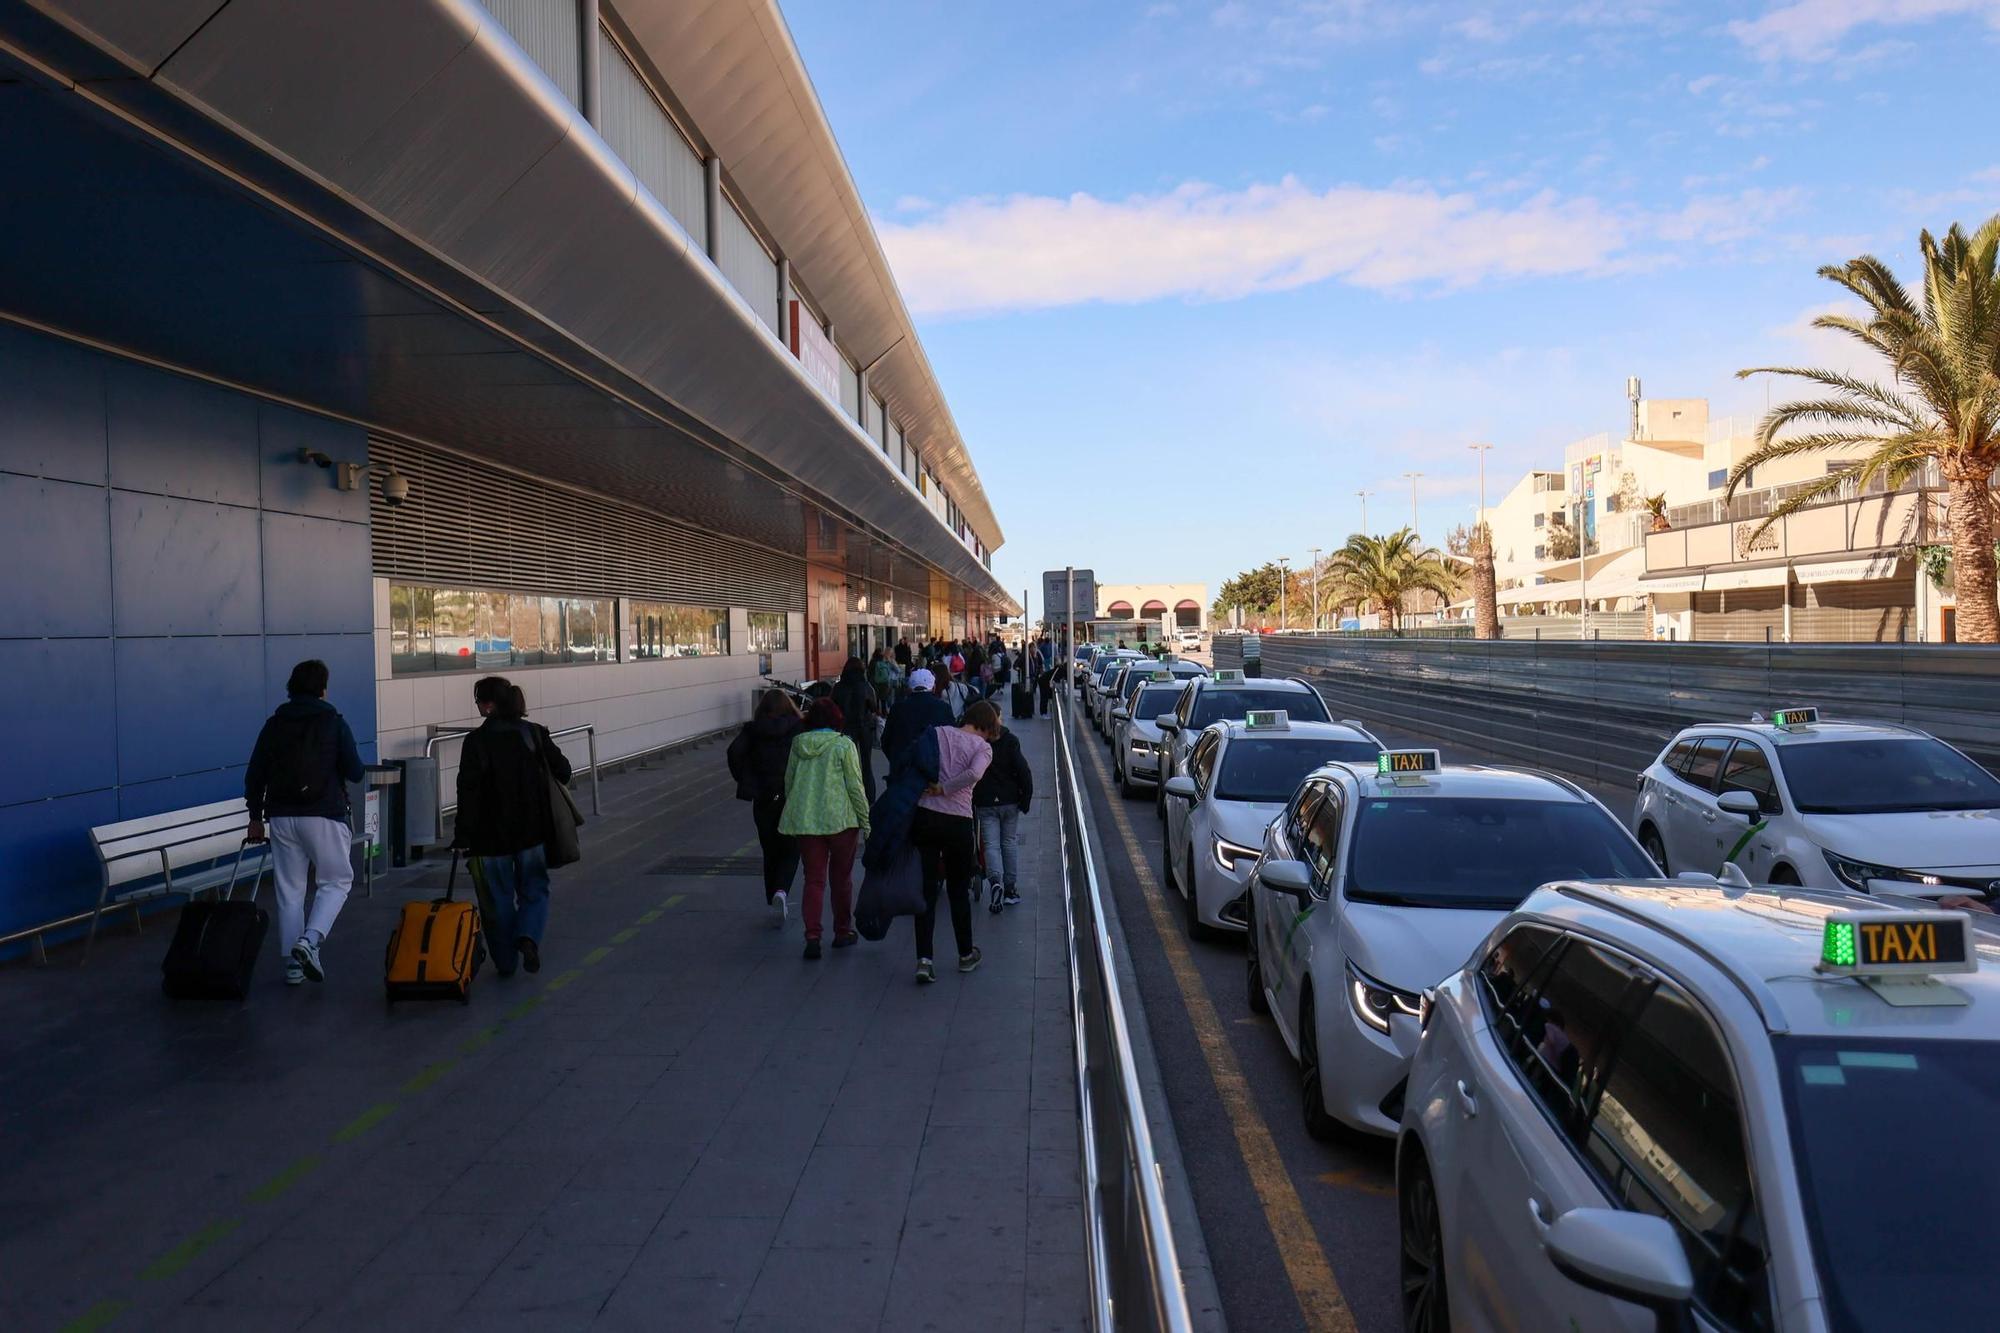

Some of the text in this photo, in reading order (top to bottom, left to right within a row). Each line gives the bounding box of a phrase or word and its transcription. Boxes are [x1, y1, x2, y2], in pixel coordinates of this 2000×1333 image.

[1785, 711, 1808, 723] TAXI
[1391, 753, 1424, 770] TAXI
[1861, 923, 1937, 962] TAXI
